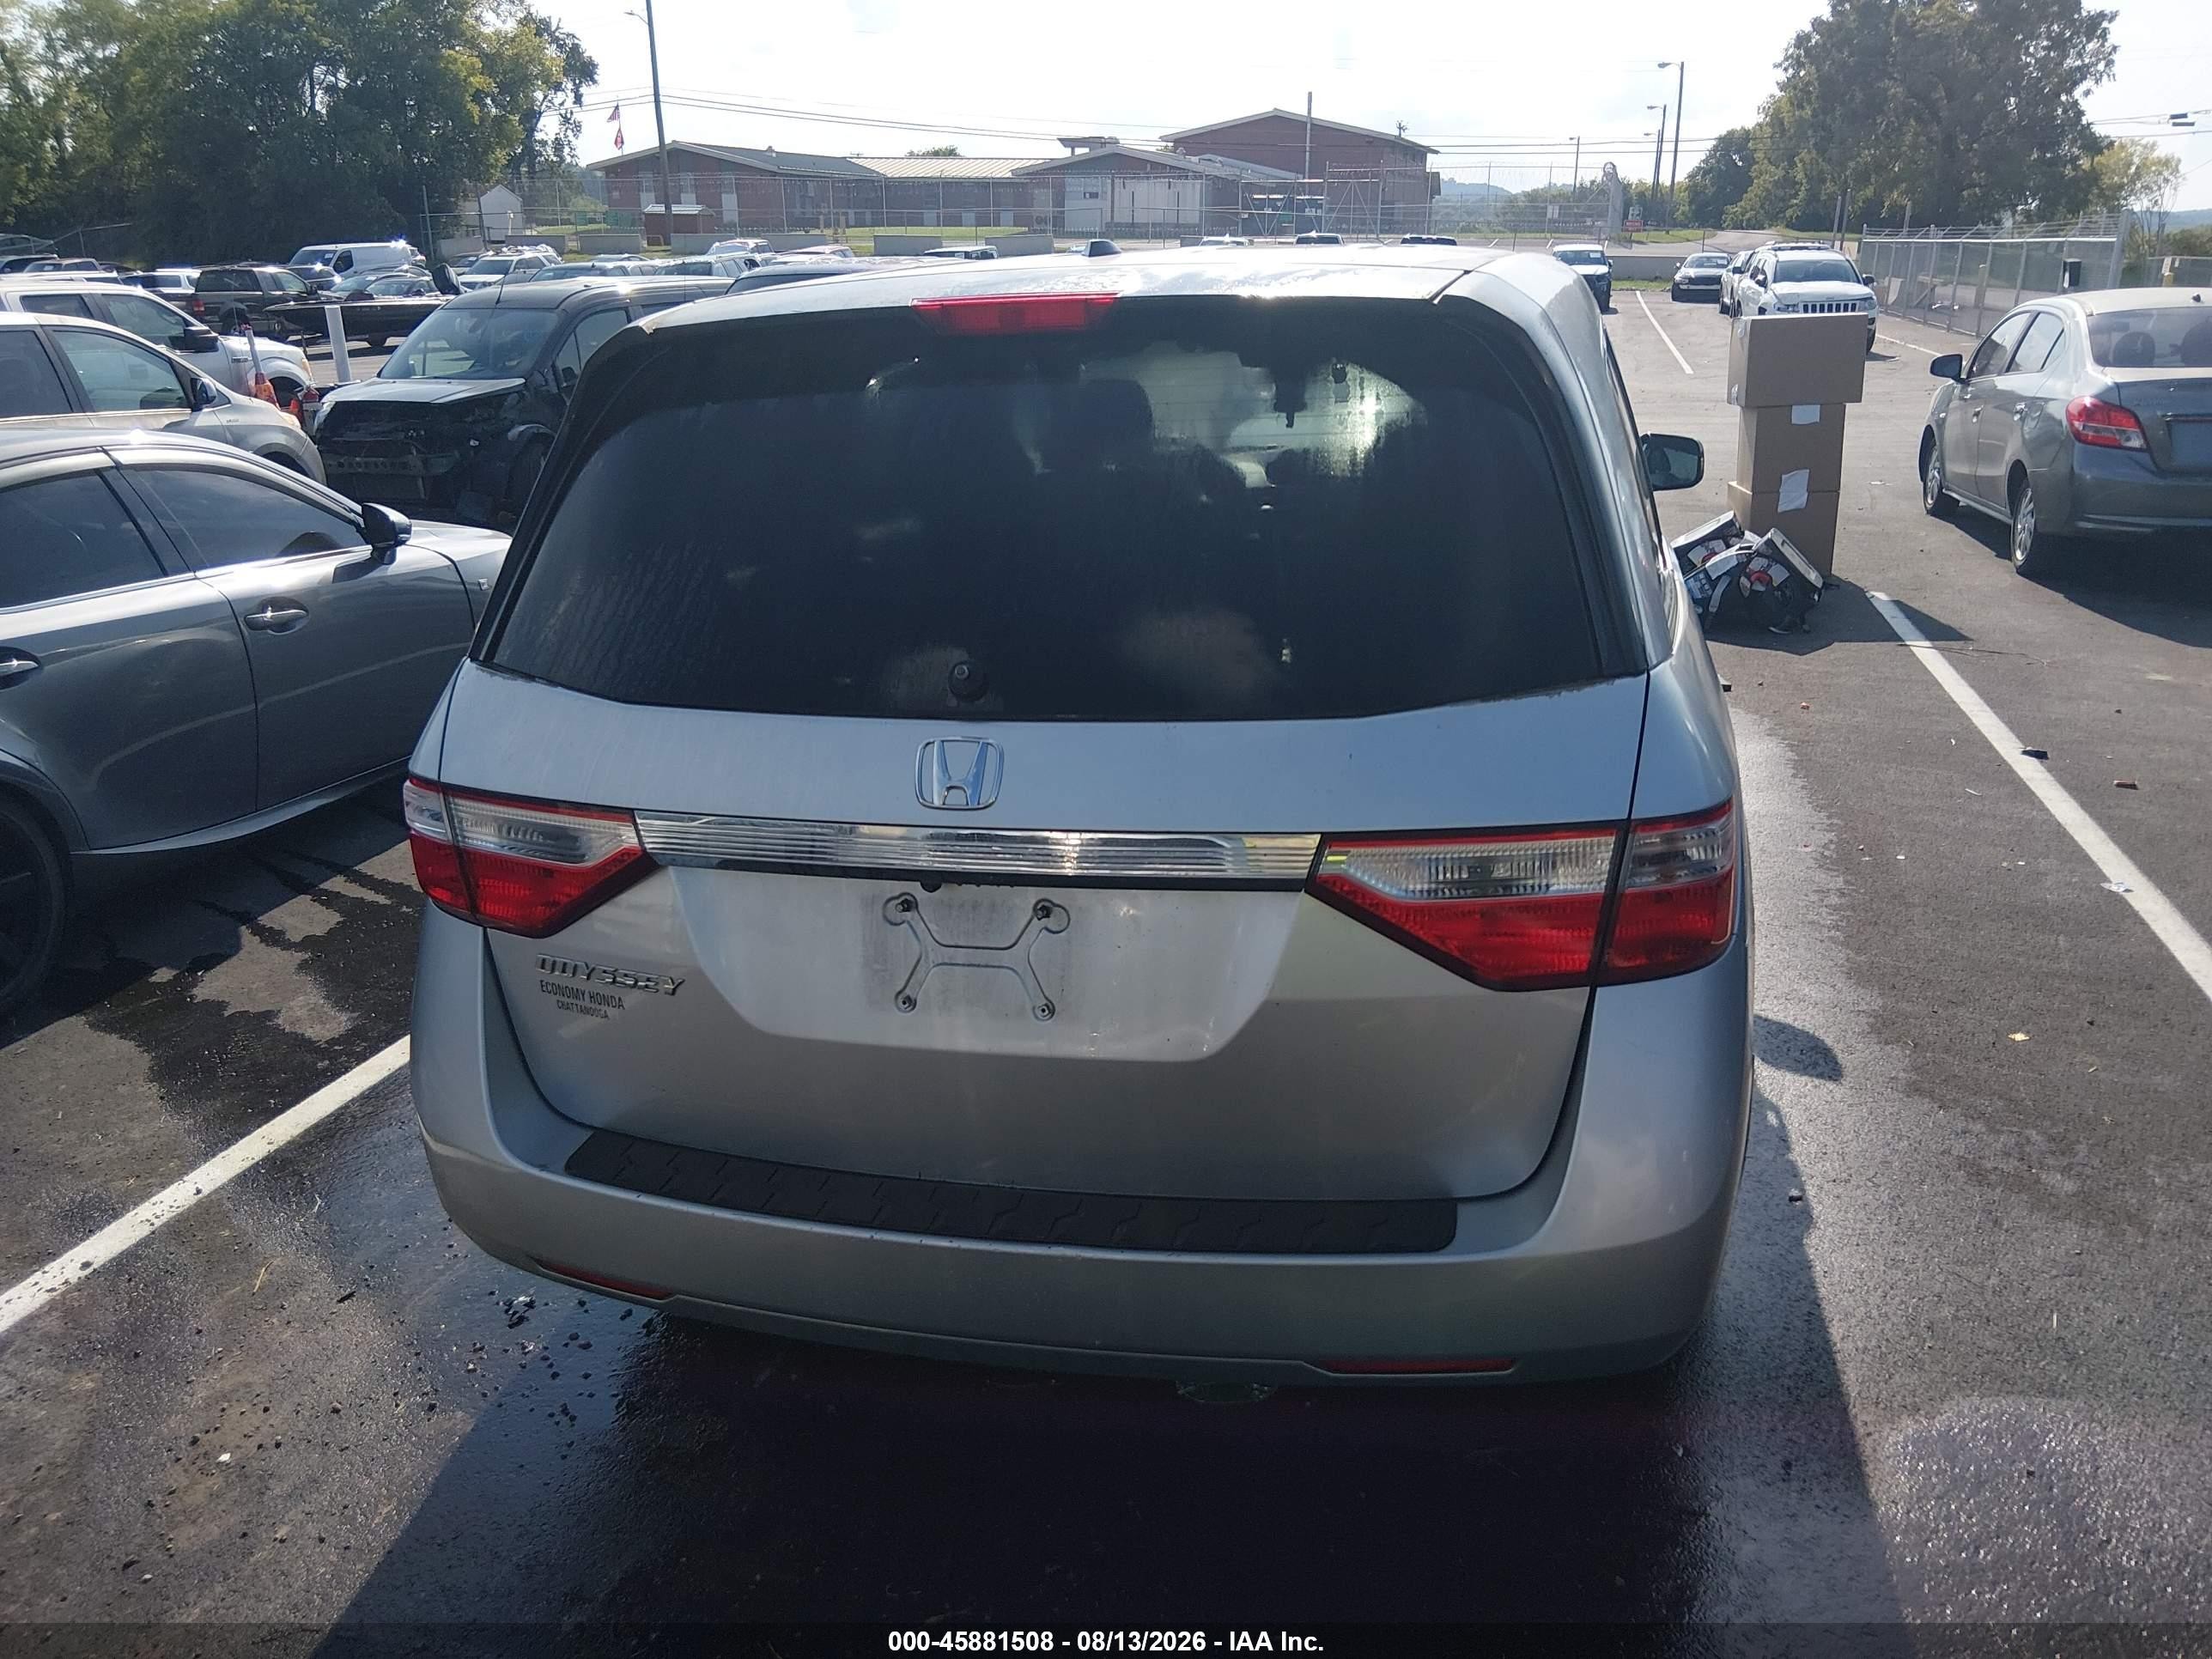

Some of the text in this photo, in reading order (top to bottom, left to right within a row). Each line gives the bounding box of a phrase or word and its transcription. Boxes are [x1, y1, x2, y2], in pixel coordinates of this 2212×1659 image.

[536, 953, 685, 996] ODYSSEY
[540, 979, 626, 1011] ECONOMY HONDA
[556, 999, 611, 1020] CHATTANOOGA
